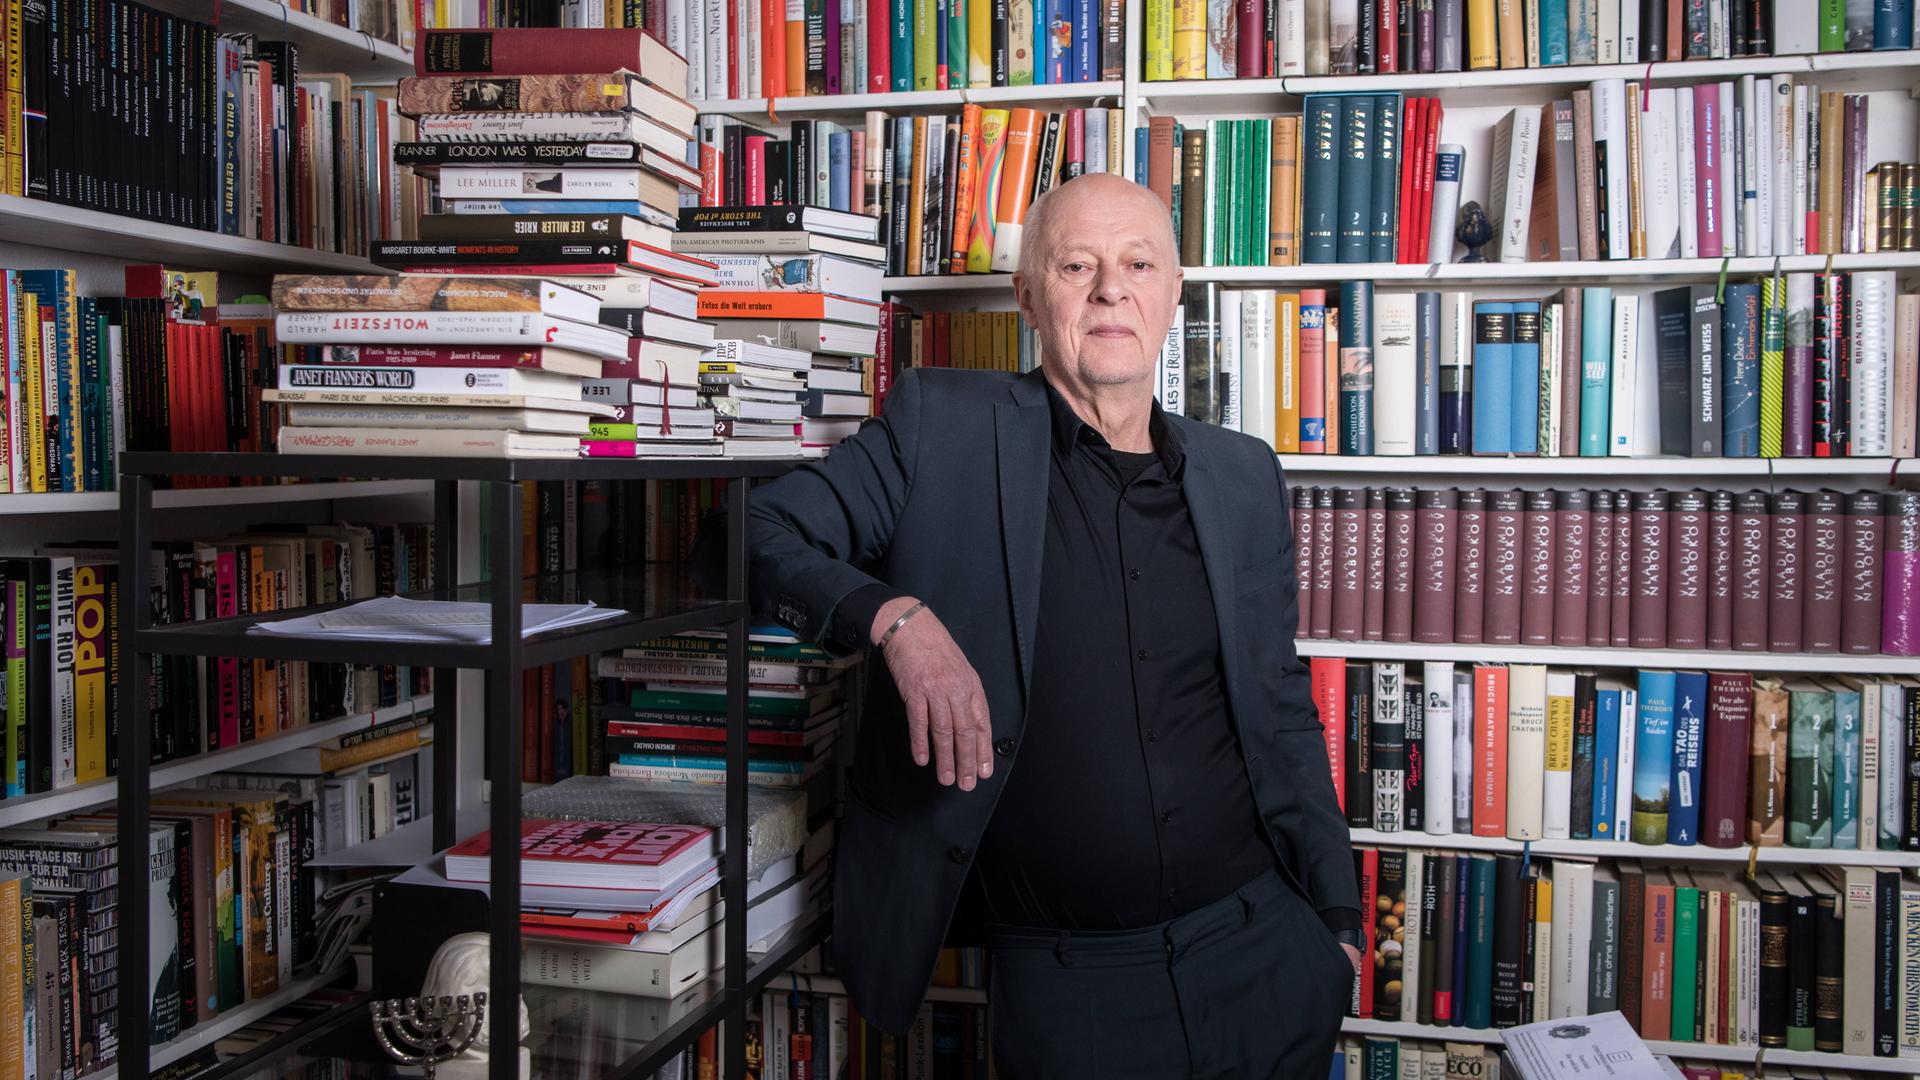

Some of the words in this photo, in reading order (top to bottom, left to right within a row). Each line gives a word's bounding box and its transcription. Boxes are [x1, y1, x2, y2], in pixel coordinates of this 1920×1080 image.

[1109, 26, 1119, 43] Bill
[996, 49, 1004, 73] bombus
[1319, 110, 1332, 160] SWIFT
[1354, 109, 1366, 160] SWIFT
[1383, 109, 1394, 159] SWIFT
[399, 145, 437, 156] FLANNER
[448, 145, 498, 157] LONDON
[502, 145, 527, 156] WAS
[533, 145, 587, 156] YESTERDAY
[1809, 153, 1817, 168] Die
[457, 178, 476, 187] LEE
[478, 178, 517, 188] MILLER
[464, 203, 487, 211] Miller
[488, 203, 501, 211] Lee
[694, 212, 709, 221] POP
[720, 212, 743, 221] STORY
[744, 211, 762, 220] THE
[515, 222, 538, 233] KRIEG
[541, 221, 569, 232] MILLER
[570, 221, 585, 233] LEE
[381, 246, 413, 255] MARGARET
[413, 246, 456, 255] BOURKE-WHITE
[342, 288, 359, 296] UND
[702, 301, 719, 309] Fotos
[720, 301, 730, 309] die
[748, 302, 772, 310] erobern
[286, 314, 327, 324] JÄHNER
[1353, 288, 1362, 328] NAIPAUL
[286, 325, 327, 334] HARALD
[332, 318, 429, 330] WOLFSZEIT
[1702, 323, 1712, 351] WEISS
[49, 326, 58, 374] COWBOY
[365, 347, 385, 356] Paris
[402, 348, 437, 357] Yesterday
[449, 351, 469, 360] Janet
[470, 351, 502, 360] Flanner
[1734, 336, 1743, 360] Dische
[1855, 332, 1863, 364] BRIAN
[292, 370, 325, 385] JANET
[375, 369, 413, 386] WORLD
[1703, 354, 1712, 374] UND
[1734, 360, 1744, 380] Irene
[51, 379, 59, 412] LOGIC
[591, 385, 611, 396] LEE
[1703, 377, 1712, 422] SCHWARZ
[1222, 405, 1230, 425] Sten
[1358, 395, 1366, 435] ELDORADO
[1350, 413, 1358, 450] ABSCHIED
[49, 438, 57, 473] FRIEDMAN
[1301, 512, 1311, 589] NABOKOV
[1347, 512, 1358, 589] NABOKOV
[1375, 512, 1385, 589] NABOKOV
[1398, 514, 1409, 592] NABOKOV
[1434, 512, 1444, 591] NABOKOV
[1469, 514, 1480, 593] NABOKOV
[1504, 516, 1515, 594] NABOKOV
[1539, 515, 1549, 594] NABOKOV
[1572, 515, 1583, 594] NABOKOV
[1600, 516, 1610, 596] NABOKOV
[1649, 515, 1660, 596] NABOKOV
[1688, 515, 1699, 597] NABOKOV
[1742, 519, 1752, 599] VLADIMIR
[1751, 519, 1761, 599] NABOKOV
[1785, 517, 1796, 599] NABOKOV
[1815, 518, 1826, 600] VLADIMIR
[1825, 519, 1836, 600] NABOKOV
[1855, 519, 1865, 601] VLADIMIR
[1864, 519, 1875, 601] NABOKOV
[56, 566, 75, 627] WHITE
[76, 566, 105, 668] POP
[56, 632, 74, 675] RIOT
[643, 651, 674, 659] CHALDEJ
[675, 652, 708, 660] JEWGENI
[1487, 674, 1495, 704] BRUCE
[1719, 696, 1732, 704] Der
[1732, 696, 1745, 704] alte
[1549, 698, 1558, 738] CHATWIN
[1562, 715, 1570, 728] ich
[1563, 699, 1571, 714] hier
[1486, 706, 1495, 748] CHATWIN
[1680, 717, 1688, 730] DES
[1769, 714, 1777, 730] 1
[1812, 714, 1821, 730] 2
[1845, 714, 1853, 730] 3
[1330, 728, 1338, 777] GERADER
[1548, 740, 1558, 768] BRUCE
[1676, 729, 1687, 754] TAO
[1687, 717, 1700, 768] REISENS
[1678, 754, 1687, 767] DAS
[395, 772, 412, 826] LIFE
[281, 840, 290, 868] Solid
[262, 861, 272, 916] Culture
[282, 871, 290, 928] Foundation
[1426, 885, 1436, 909] ROTH
[58, 907, 68, 945] JESUS
[1407, 901, 1418, 935] ROTH
[1605, 889, 1615, 943] Landkarten
[265, 916, 273, 953] Bass
[59, 947, 70, 984] BLACK
[583, 957, 591, 982] WELT
[1605, 944, 1614, 969] ohne
[1603, 971, 1612, 998] Reise
[63, 998, 71, 1031] FELICE
[1446, 1060, 1483, 1076] ECO
